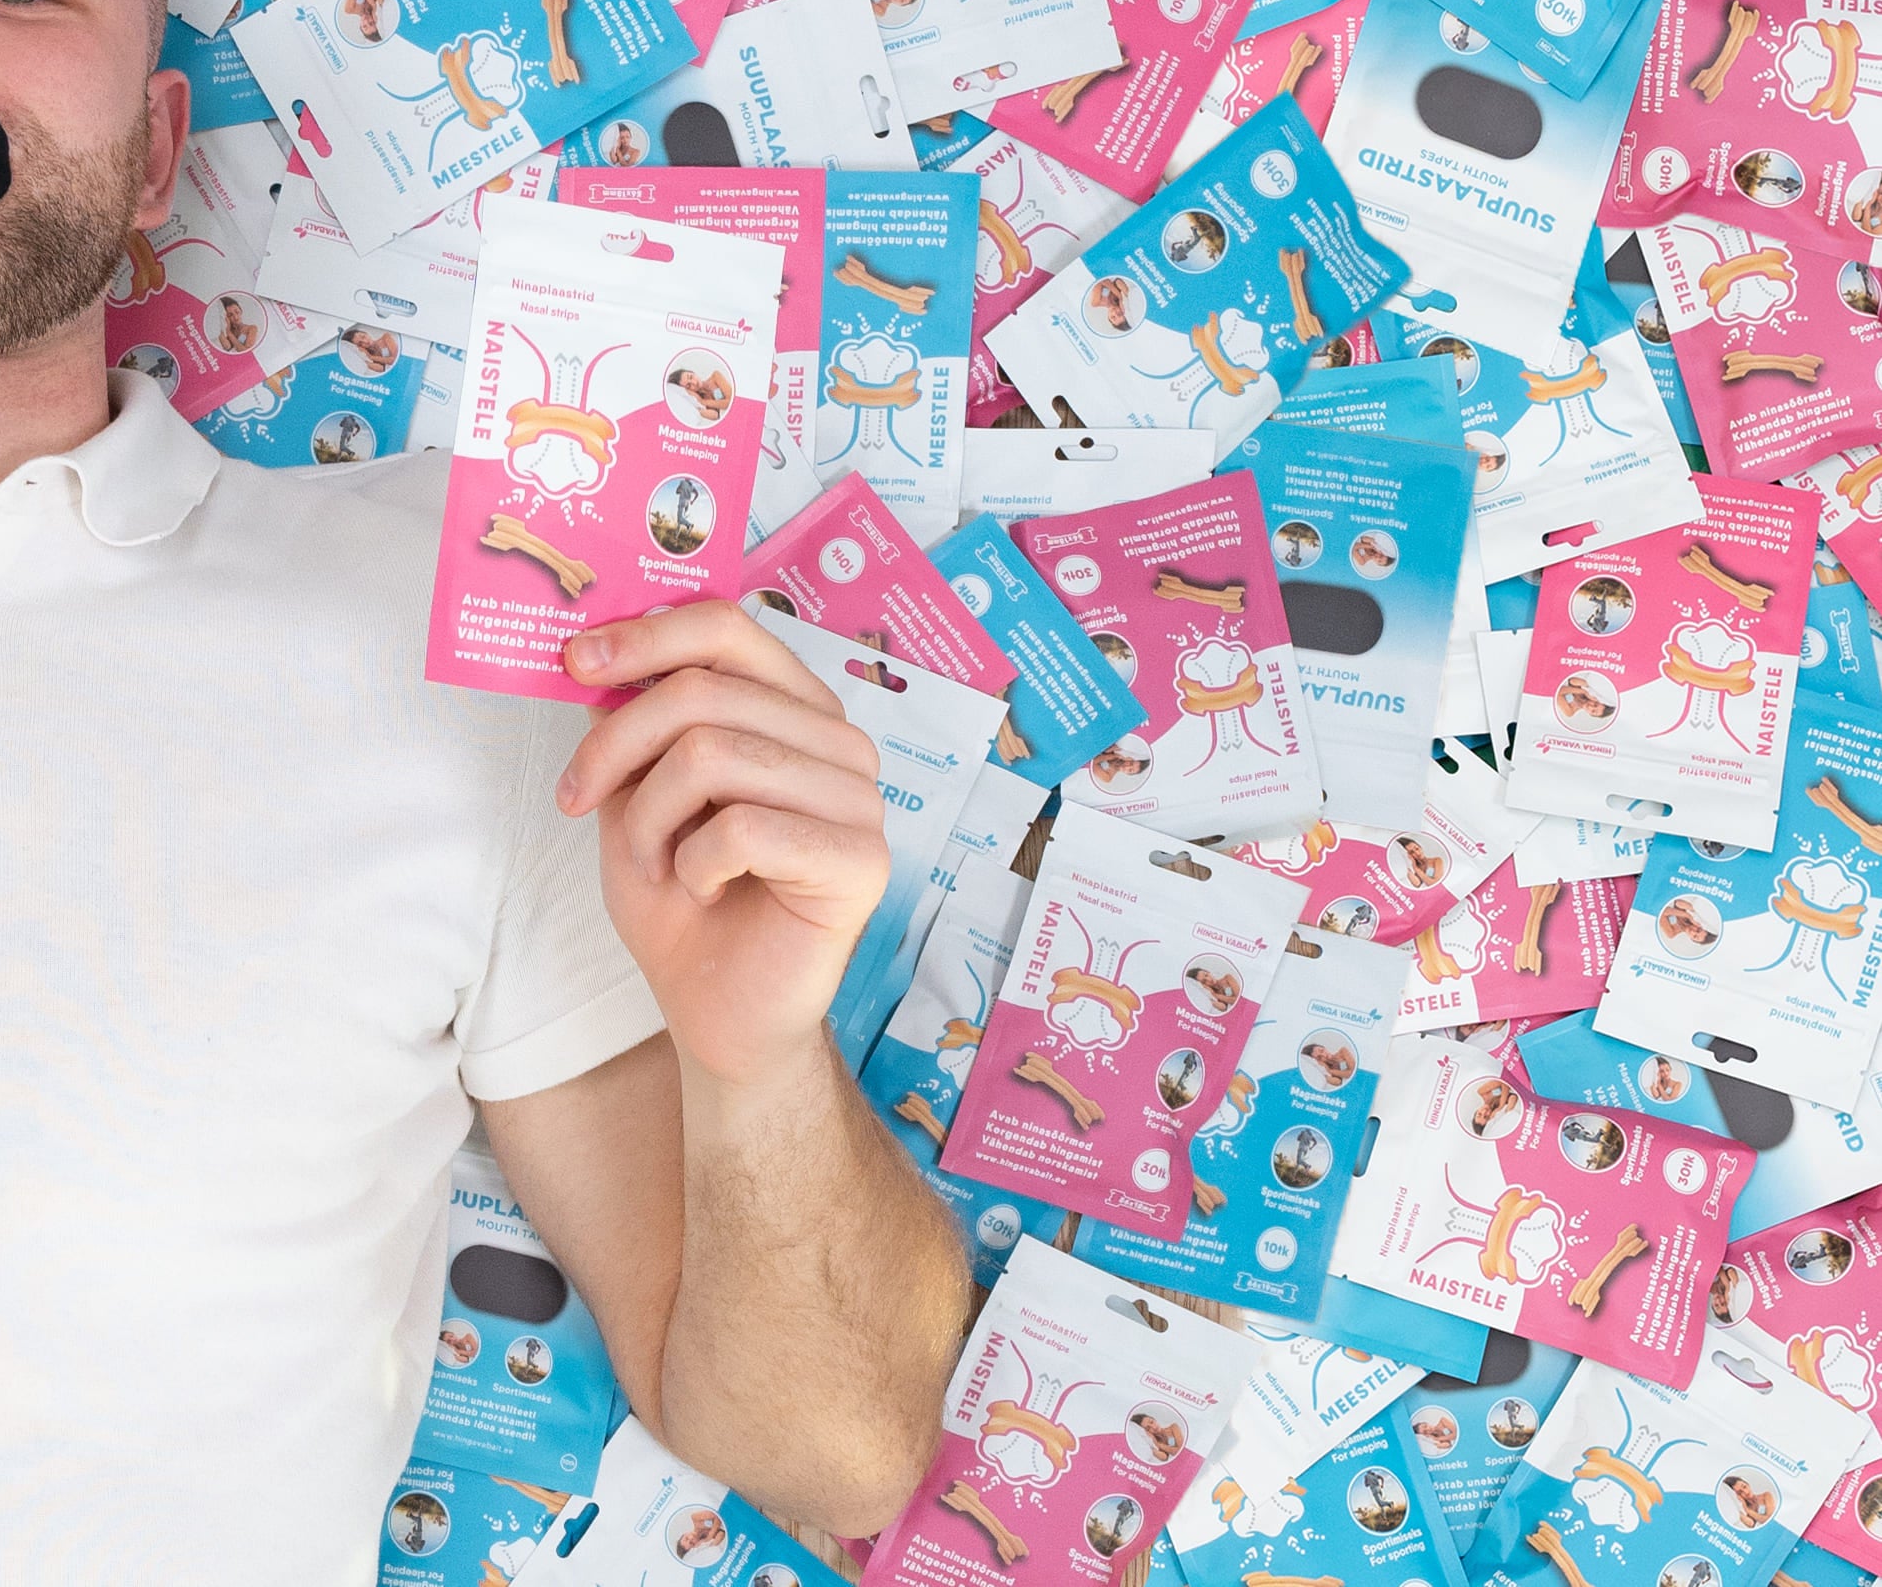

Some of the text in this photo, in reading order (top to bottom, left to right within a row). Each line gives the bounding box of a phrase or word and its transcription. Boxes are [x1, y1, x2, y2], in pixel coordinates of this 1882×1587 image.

[431, 125, 524, 190] MEESTELE
[511, 277, 595, 303] Ninaplaastrid
[520, 301, 580, 322] Nasal strips
[670, 318, 741, 340] HINGA VABALT
[472, 320, 506, 440] NAISTELE
[928, 367, 950, 468] MEESTELE
[658, 424, 727, 449] Magamiseks
[661, 440, 719, 464] For sleeping
[981, 494, 1052, 507] Ninaplaastrid
[637, 555, 710, 579] Sportimiseks
[643, 569, 701, 592] For sporting
[461, 593, 587, 623] Avab ninasõõrmed
[459, 609, 536, 633] Kergendab
[457, 625, 526, 649] Vähendab
[454, 650, 563, 672] www.hingavabalt.ee
[1266, 661, 1300, 756] NAISTELE
[1755, 667, 1783, 757] NAISTELE
[1021, 900, 1064, 995] NAISTELE
[1260, 1185, 1321, 1209] Sportimiseks
[983, 1215, 1015, 1241] 30tk
[1264, 1241, 1290, 1257] 10tk
[1409, 1268, 1508, 1312] NAISTELE
[955, 1331, 1006, 1423] NAISTELE
[492, 1382, 552, 1405] Sportimiseks
